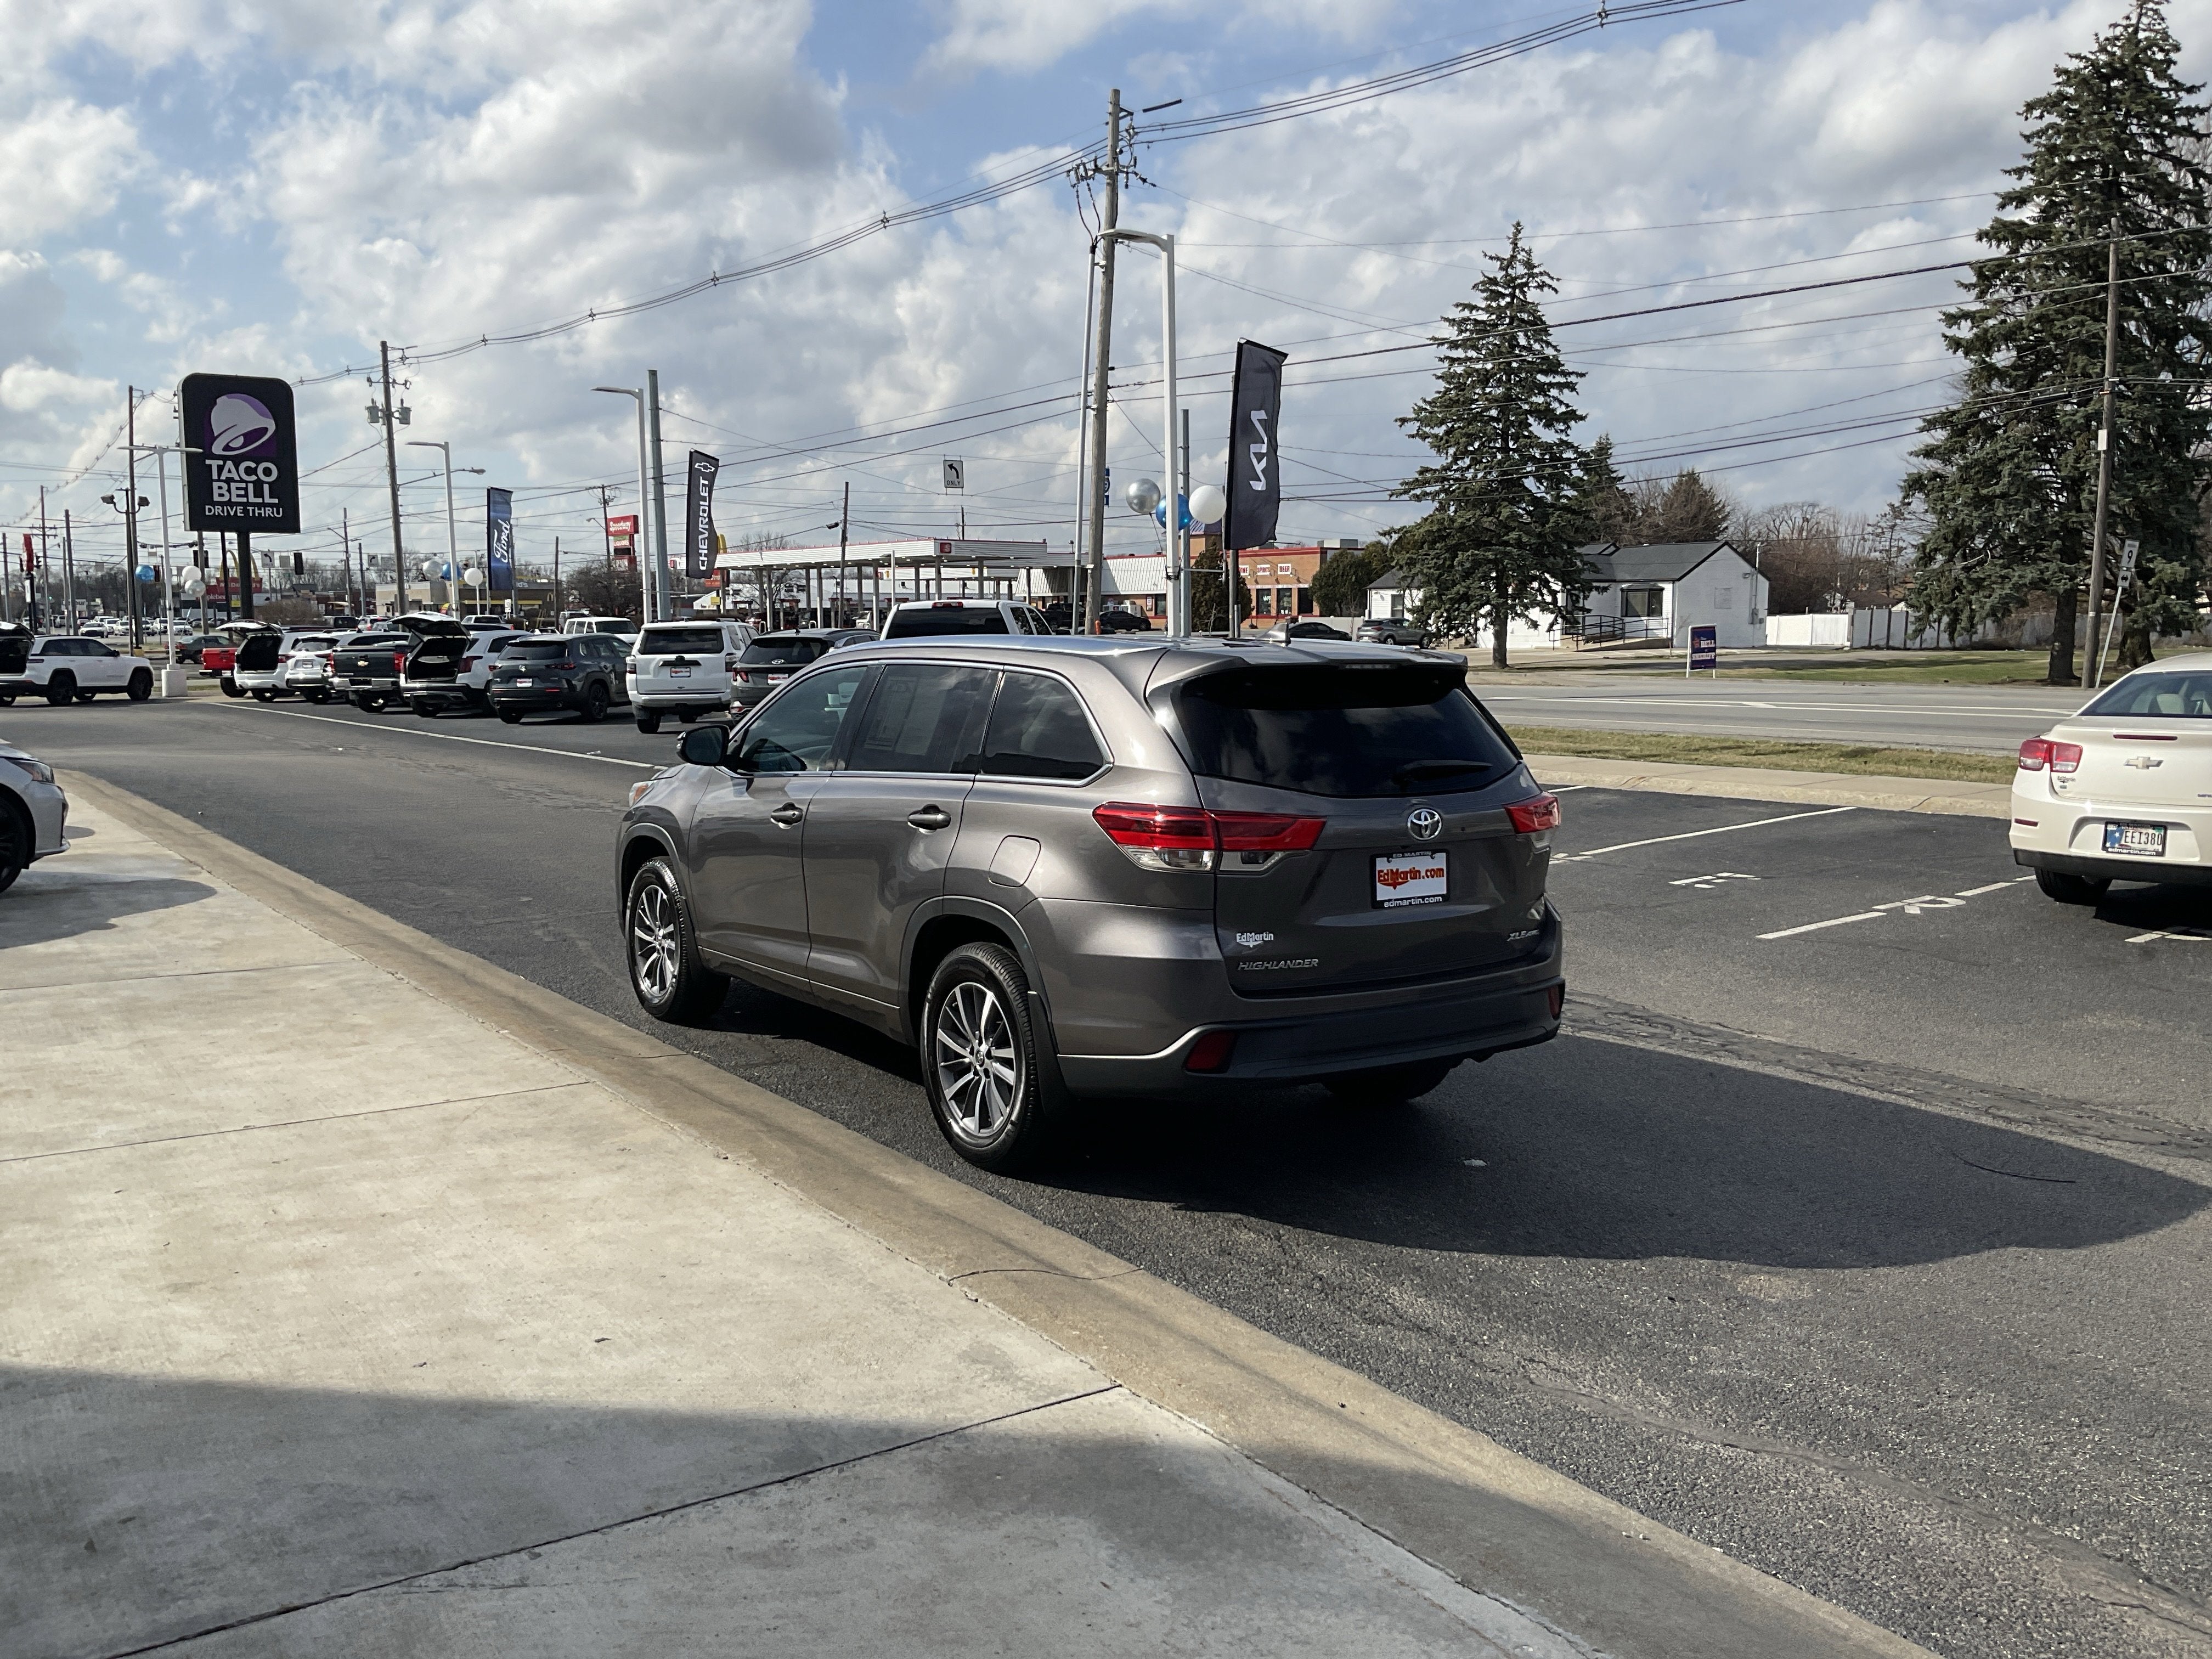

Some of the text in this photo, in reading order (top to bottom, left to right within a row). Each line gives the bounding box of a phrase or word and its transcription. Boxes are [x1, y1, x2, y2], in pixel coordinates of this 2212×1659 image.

[205, 459, 278, 482] TACO
[212, 482, 278, 504] BELL
[205, 505, 283, 517] DRIVE THRU
[698, 476, 709, 571] CHEVROLET
[494, 519, 511, 563] Ford
[2128, 550, 2133, 565] 9
[2124, 831, 2163, 845] EEI380
[2108, 848, 2156, 856] edmartin.com
[1384, 896, 1442, 907] edmartin.com
[1236, 932, 1274, 943] EdMartin
[1237, 958, 1318, 970] HIGHLANDER
